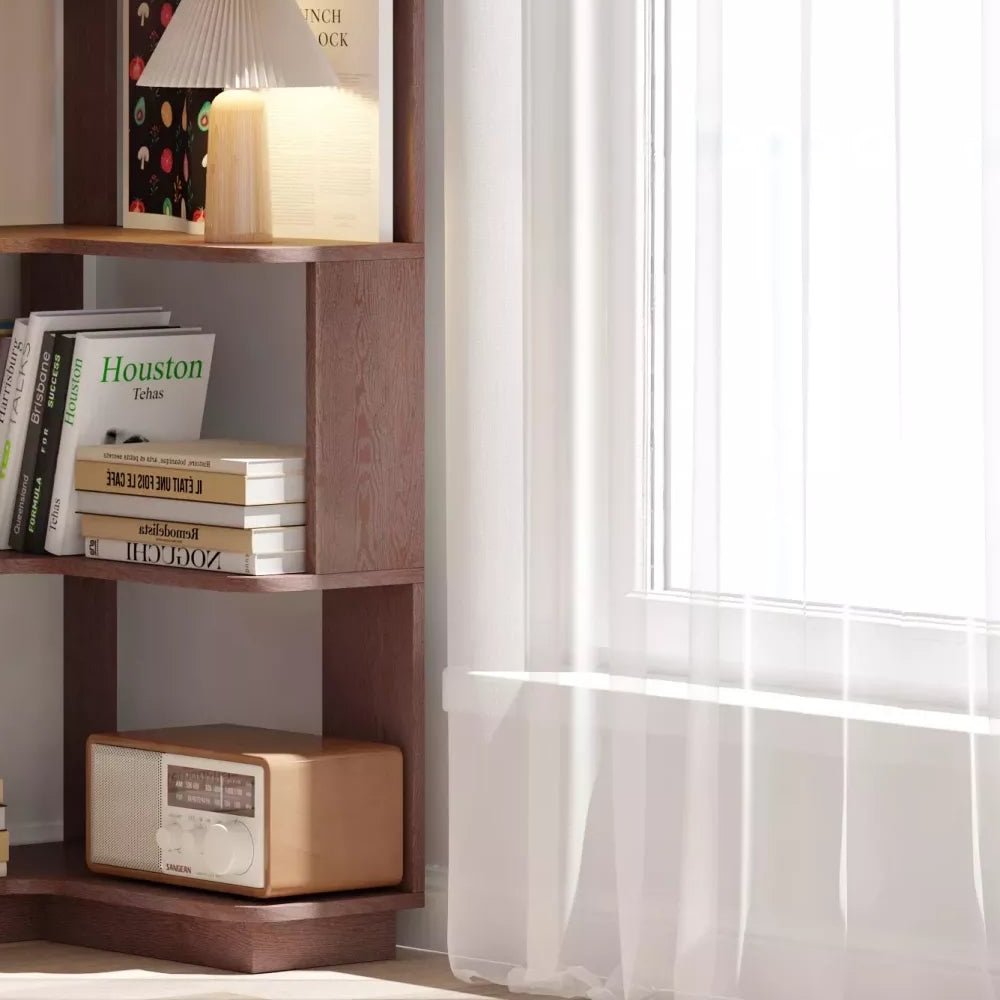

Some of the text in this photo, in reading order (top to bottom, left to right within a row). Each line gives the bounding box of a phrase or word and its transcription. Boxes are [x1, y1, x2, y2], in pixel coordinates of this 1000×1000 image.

[30, 350, 51, 425] Brisbane
[64, 357, 83, 427] Houston
[100, 356, 203, 383] Houston
[133, 387, 164, 400] Tehas
[28, 353, 61, 533] FORMULA FOR SUCCESS
[13, 474, 29, 535] Queensland
[166, 863, 192, 874] SANGEAN
